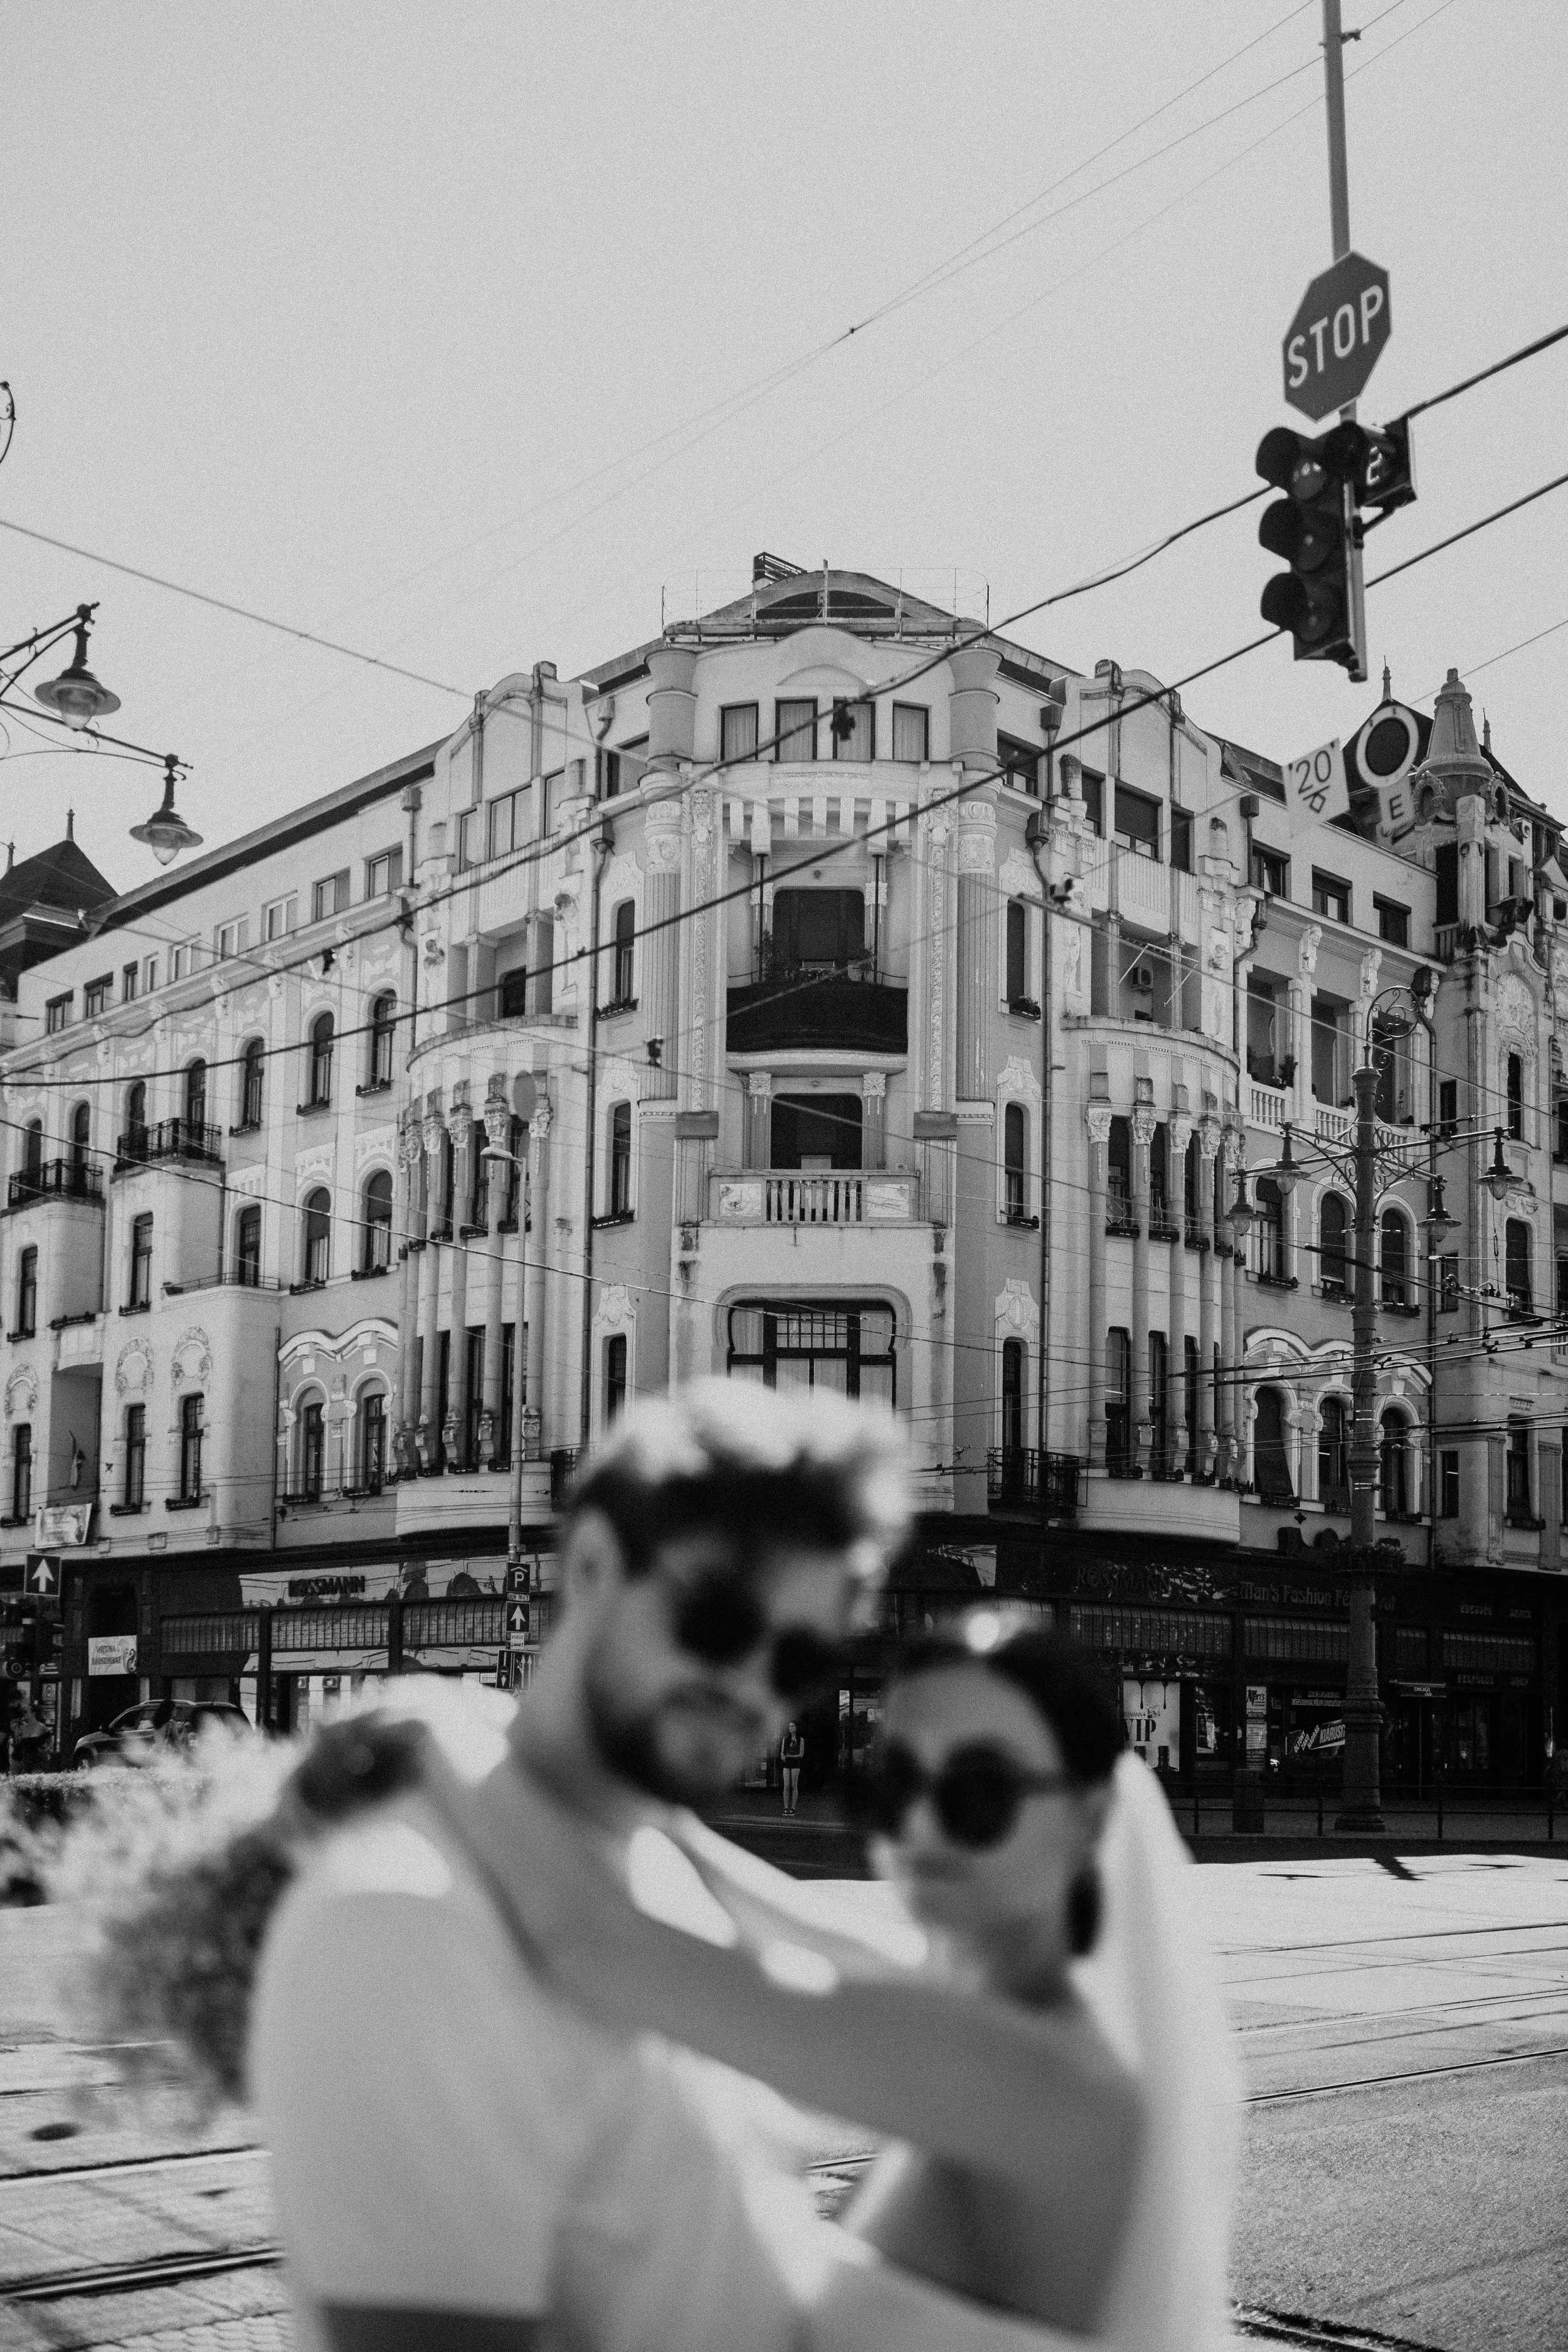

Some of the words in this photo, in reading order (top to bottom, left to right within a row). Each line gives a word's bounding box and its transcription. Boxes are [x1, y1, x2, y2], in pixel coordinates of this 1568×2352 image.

[1288, 284, 1384, 388] STOP
[1296, 749, 1332, 795] 20
[1389, 793, 1404, 820] E
[514, 1571, 525, 1588] P
[1283, 1584, 1331, 1607] Fashion
[1123, 1719, 1157, 1742] VIP
